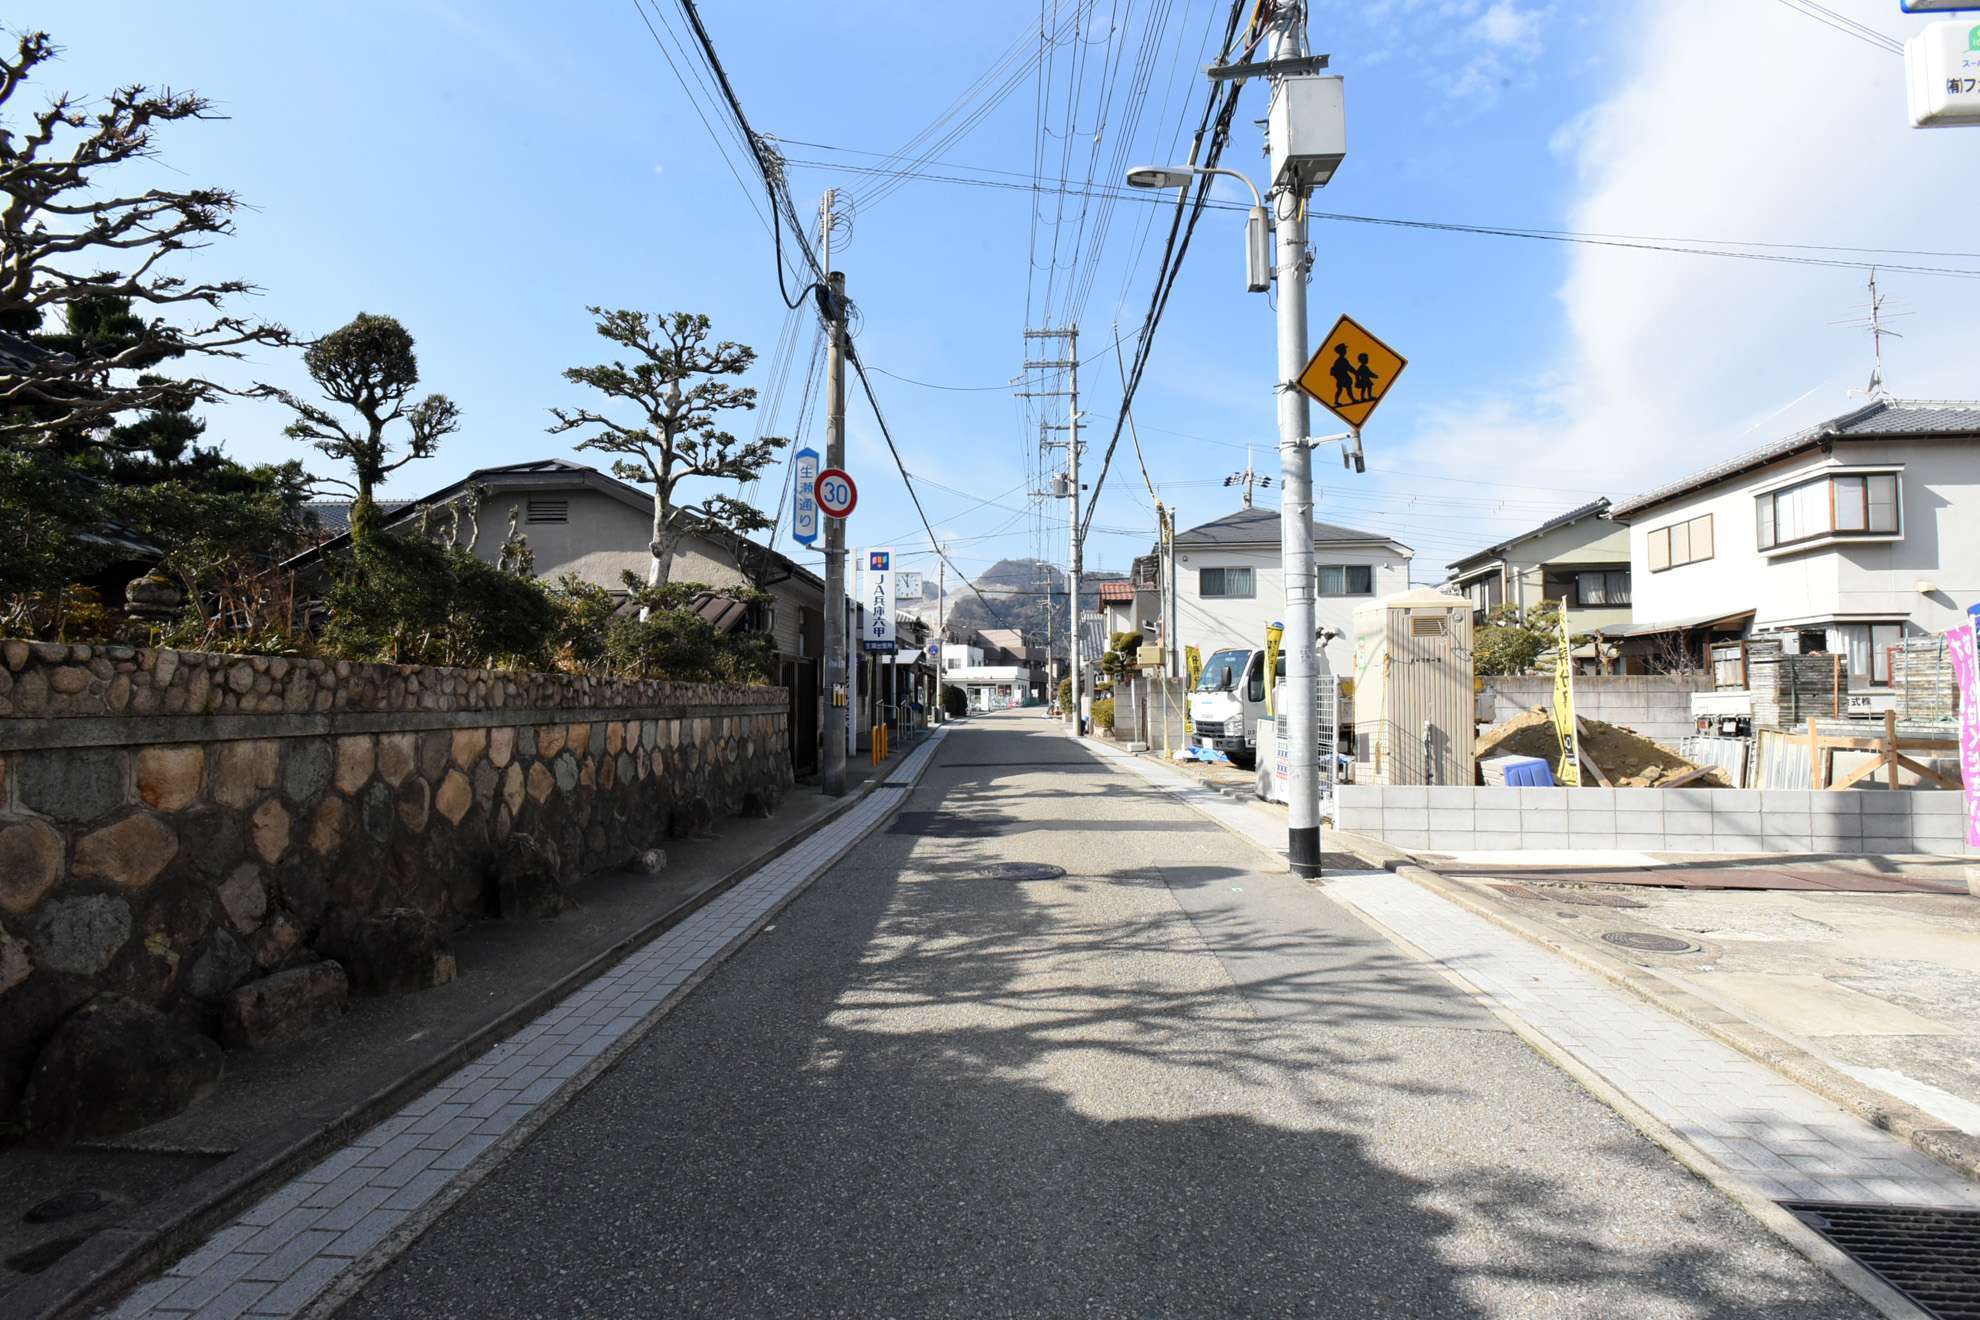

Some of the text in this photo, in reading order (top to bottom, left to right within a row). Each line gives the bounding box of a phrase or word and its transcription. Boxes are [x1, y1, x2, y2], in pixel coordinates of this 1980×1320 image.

[800, 465, 813, 527] 生瀬通り
[824, 482, 848, 505] 30
[873, 574, 886, 638] JA兵庫六甲
